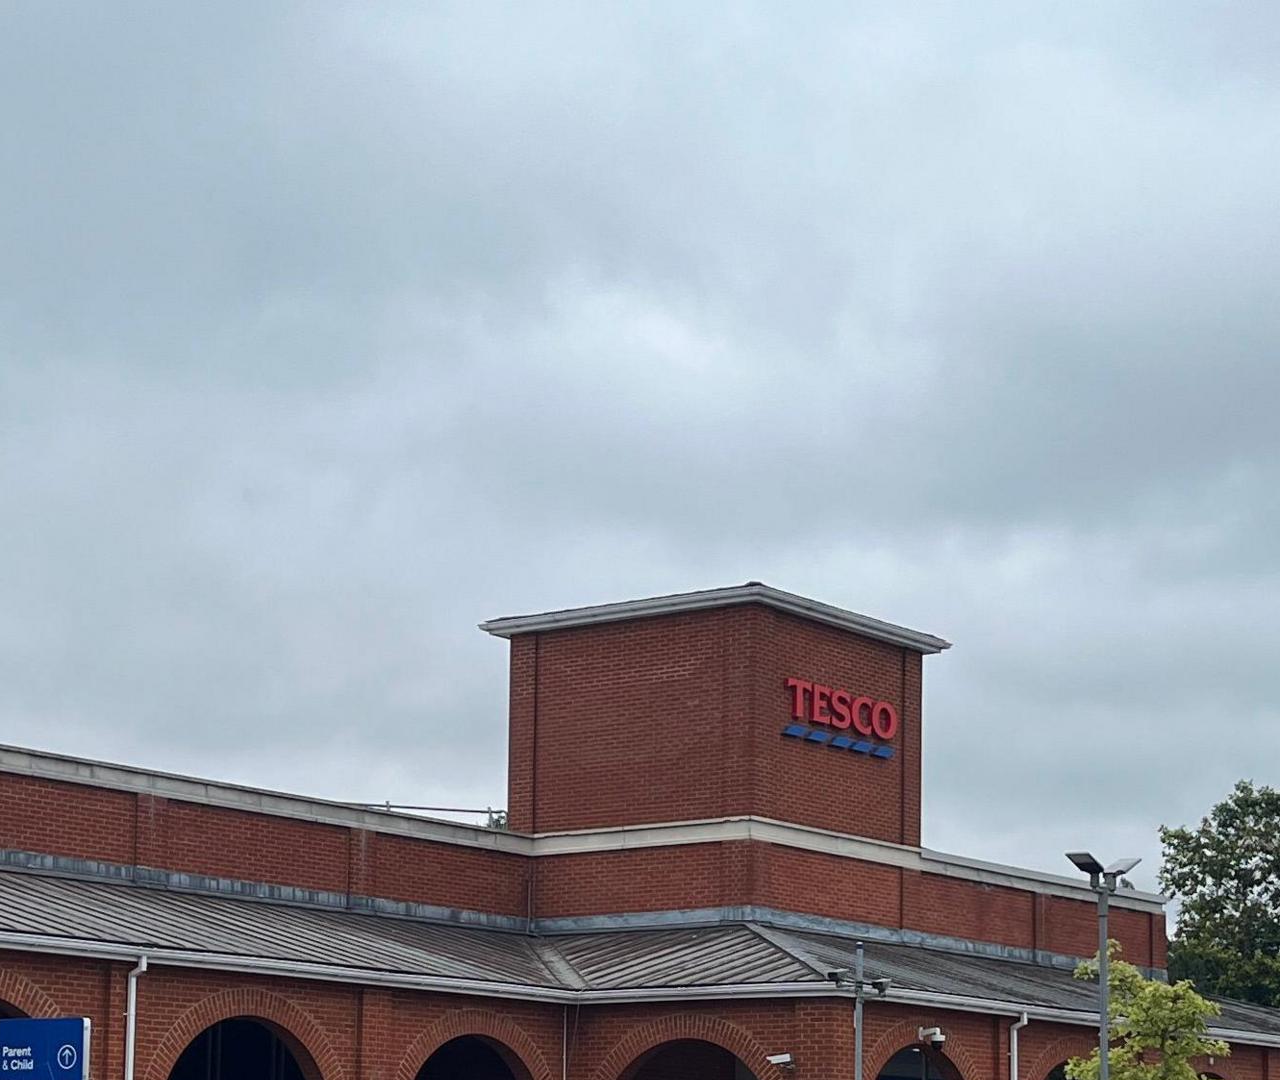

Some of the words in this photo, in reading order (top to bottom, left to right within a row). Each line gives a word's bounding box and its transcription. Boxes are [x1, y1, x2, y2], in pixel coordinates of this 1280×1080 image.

[784, 677, 897, 740] TESCO
[2, 1046, 32, 1057] Parent
[2, 1060, 9, 1071] &
[10, 1059, 34, 1070] Child
